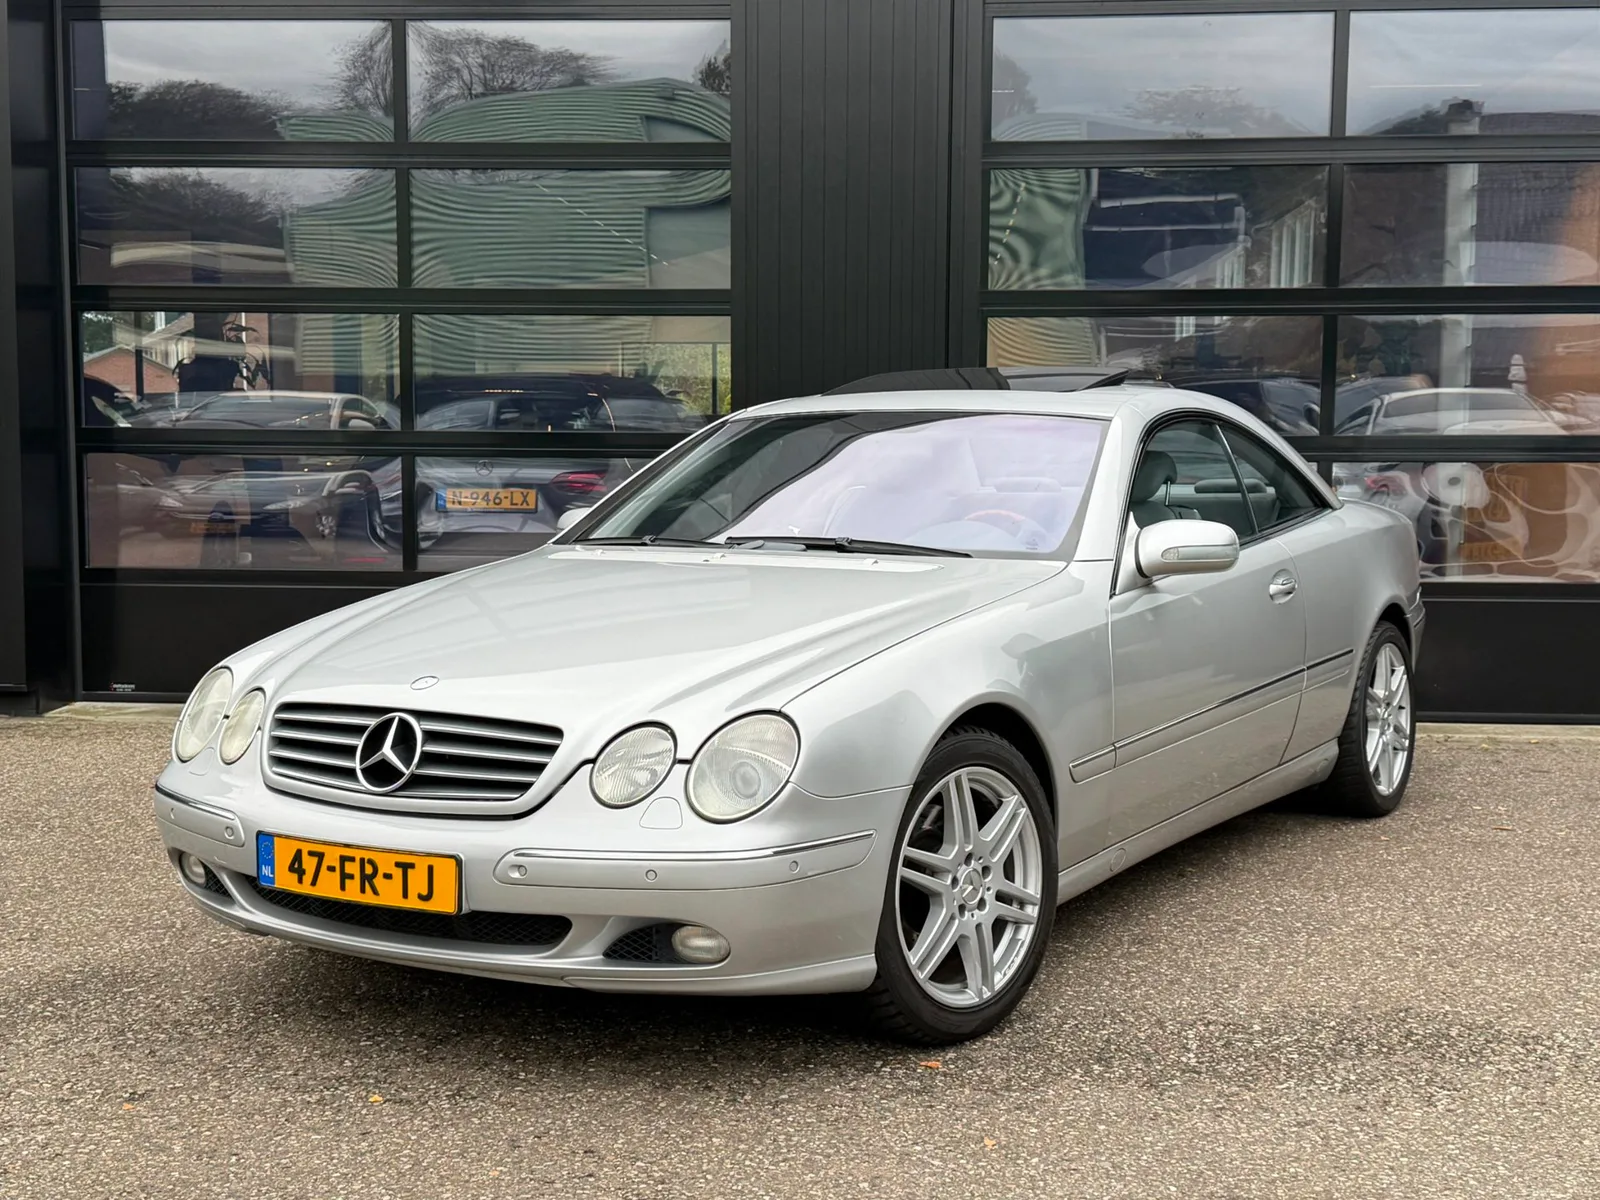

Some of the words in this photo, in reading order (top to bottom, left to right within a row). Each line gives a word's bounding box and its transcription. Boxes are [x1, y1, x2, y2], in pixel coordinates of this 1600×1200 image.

[451, 491, 529, 506] N-946-LX
[262, 865, 274, 878] NL
[287, 848, 434, 902] 47-FR-TJ
